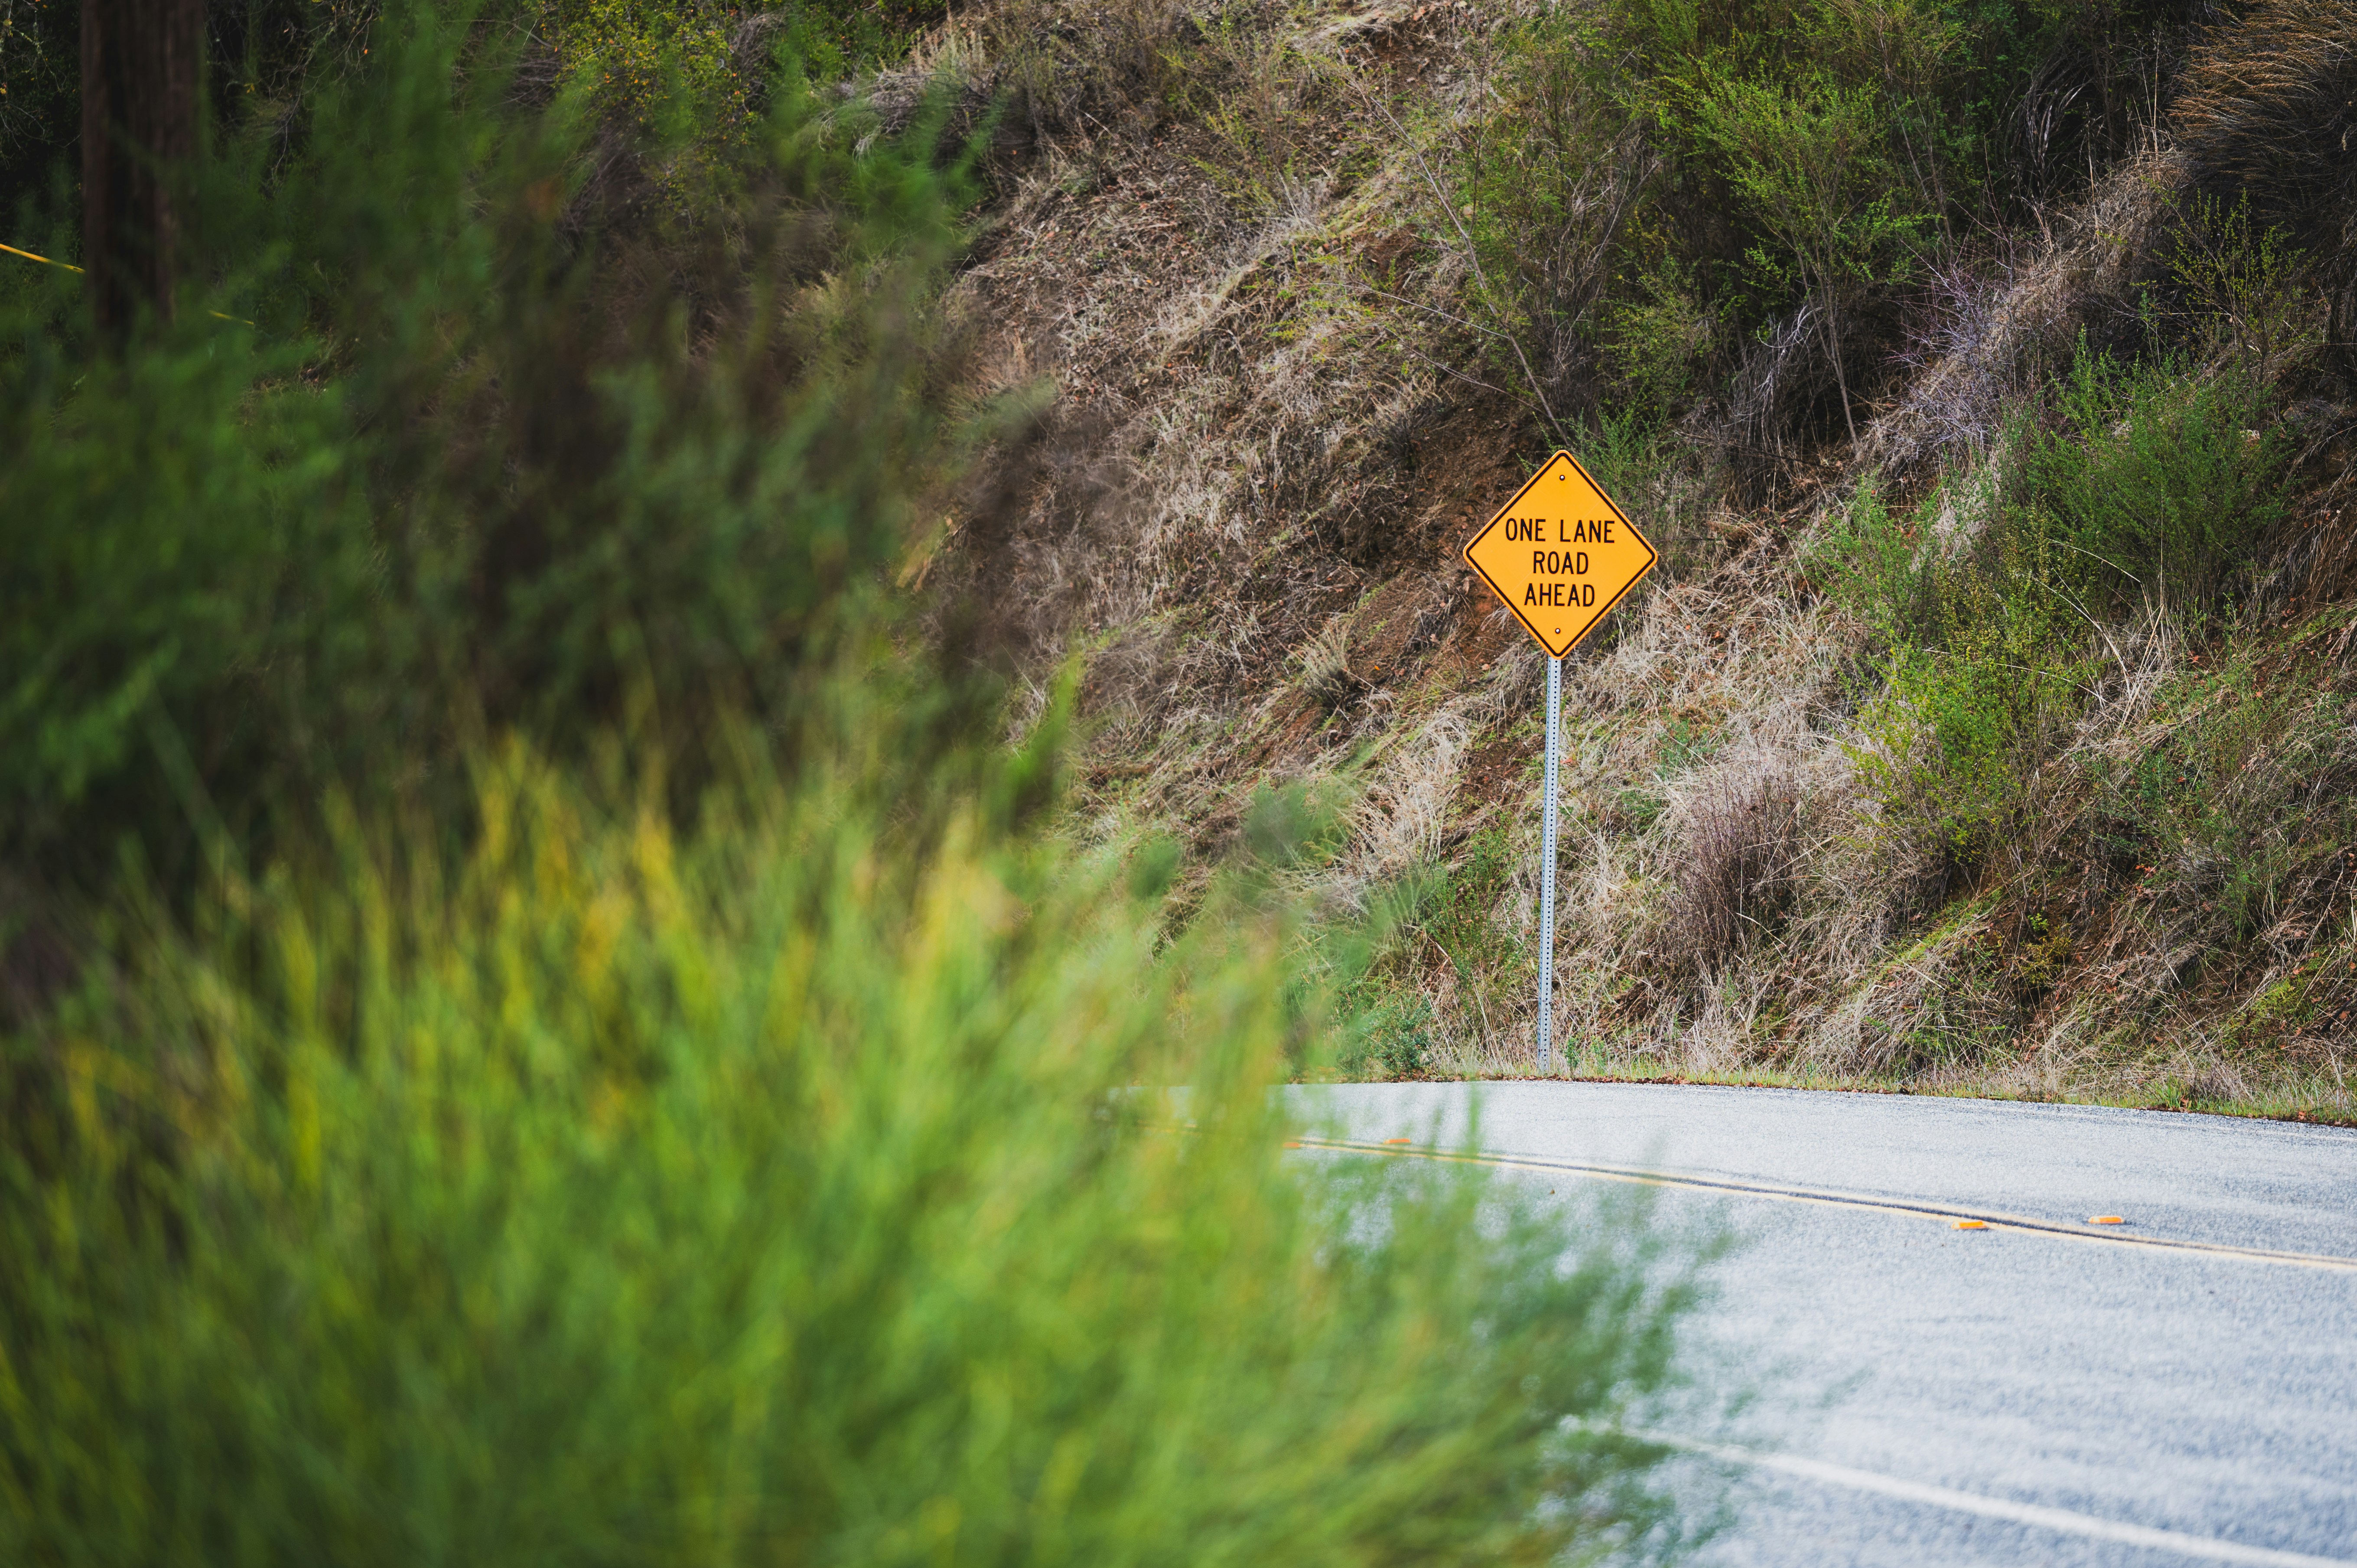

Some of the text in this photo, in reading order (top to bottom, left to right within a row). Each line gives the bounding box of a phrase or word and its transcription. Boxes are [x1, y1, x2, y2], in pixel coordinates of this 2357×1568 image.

[1505, 518, 1615, 543] ONE LANE
[1533, 551, 1588, 575] ROAD
[1524, 583, 1595, 607] AHEAD
